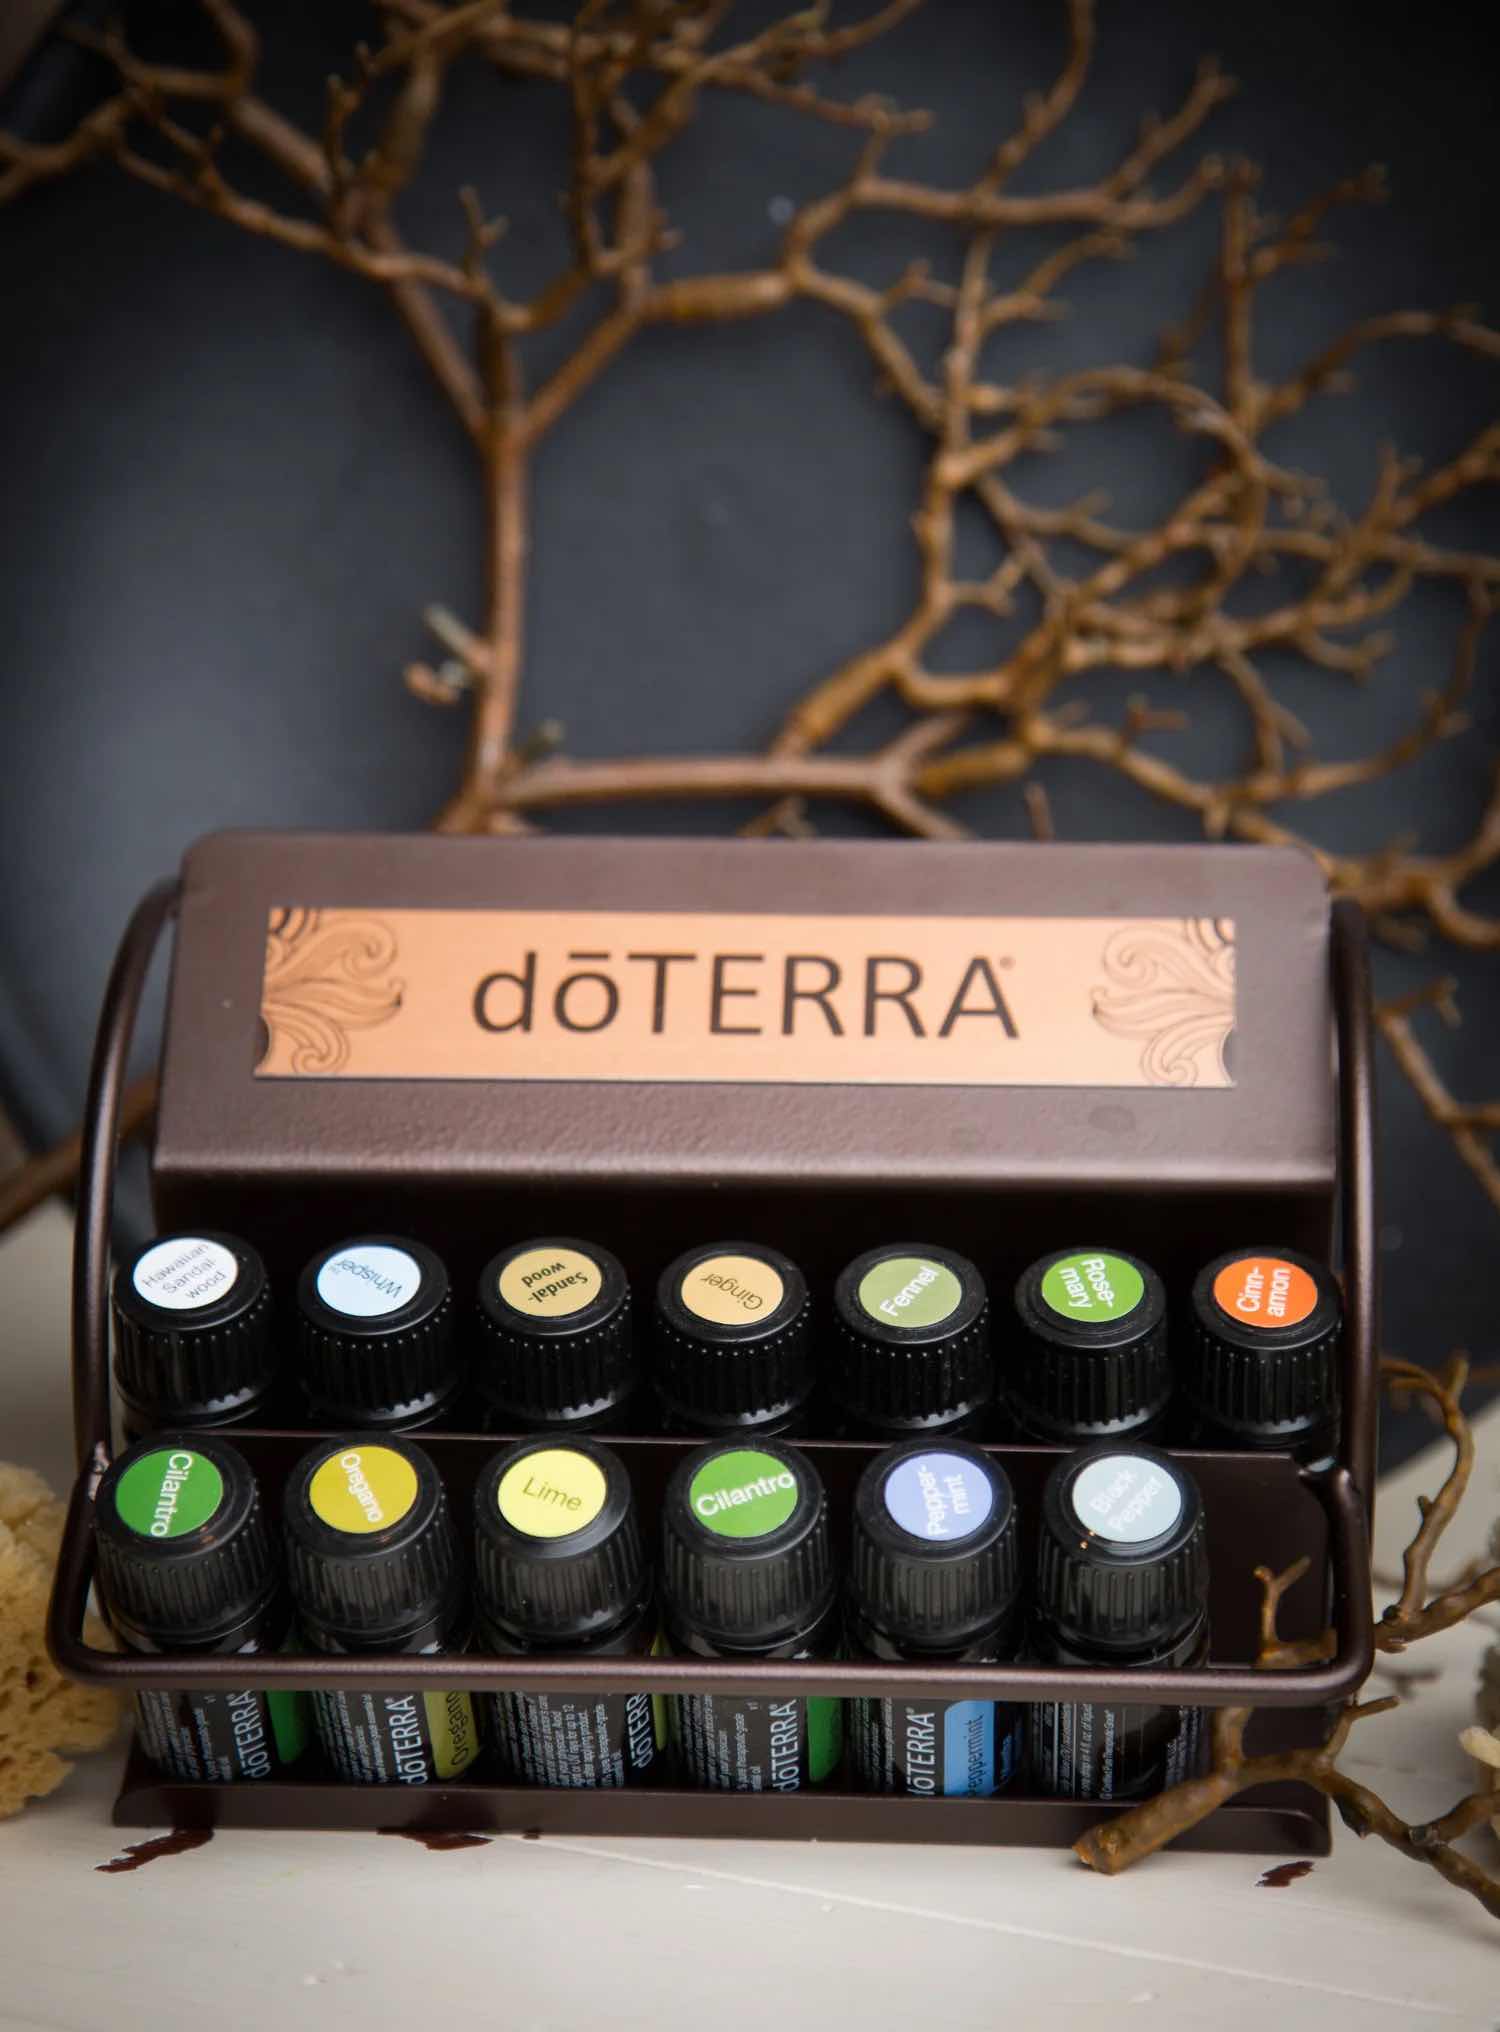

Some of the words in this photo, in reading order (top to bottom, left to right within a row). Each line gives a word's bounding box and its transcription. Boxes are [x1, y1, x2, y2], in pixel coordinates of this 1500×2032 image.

[142, 1244, 209, 1288] Hawaiian
[185, 1271, 227, 1299] wood
[521, 1262, 566, 1288] wood
[528, 1272, 588, 1303] Sandal-
[1059, 1267, 1093, 1307] mary
[1082, 1258, 1115, 1308] Rose-
[700, 1273, 763, 1310] Ginger
[880, 1266, 940, 1316] Fennel
[1236, 1267, 1264, 1312] Cinn-
[1267, 1268, 1290, 1317] amon
[150, 1453, 193, 1537] Cilantro
[341, 1453, 384, 1522] Oregano
[522, 1476, 582, 1511] Lime
[696, 1472, 796, 1516] Cilantro
[918, 1464, 948, 1536] Pepper-
[944, 1473, 970, 1514] mint
[1089, 1470, 1138, 1514] Black
[1106, 1476, 1162, 1532] Pepper
[964, 1713, 985, 1792] eppermint
